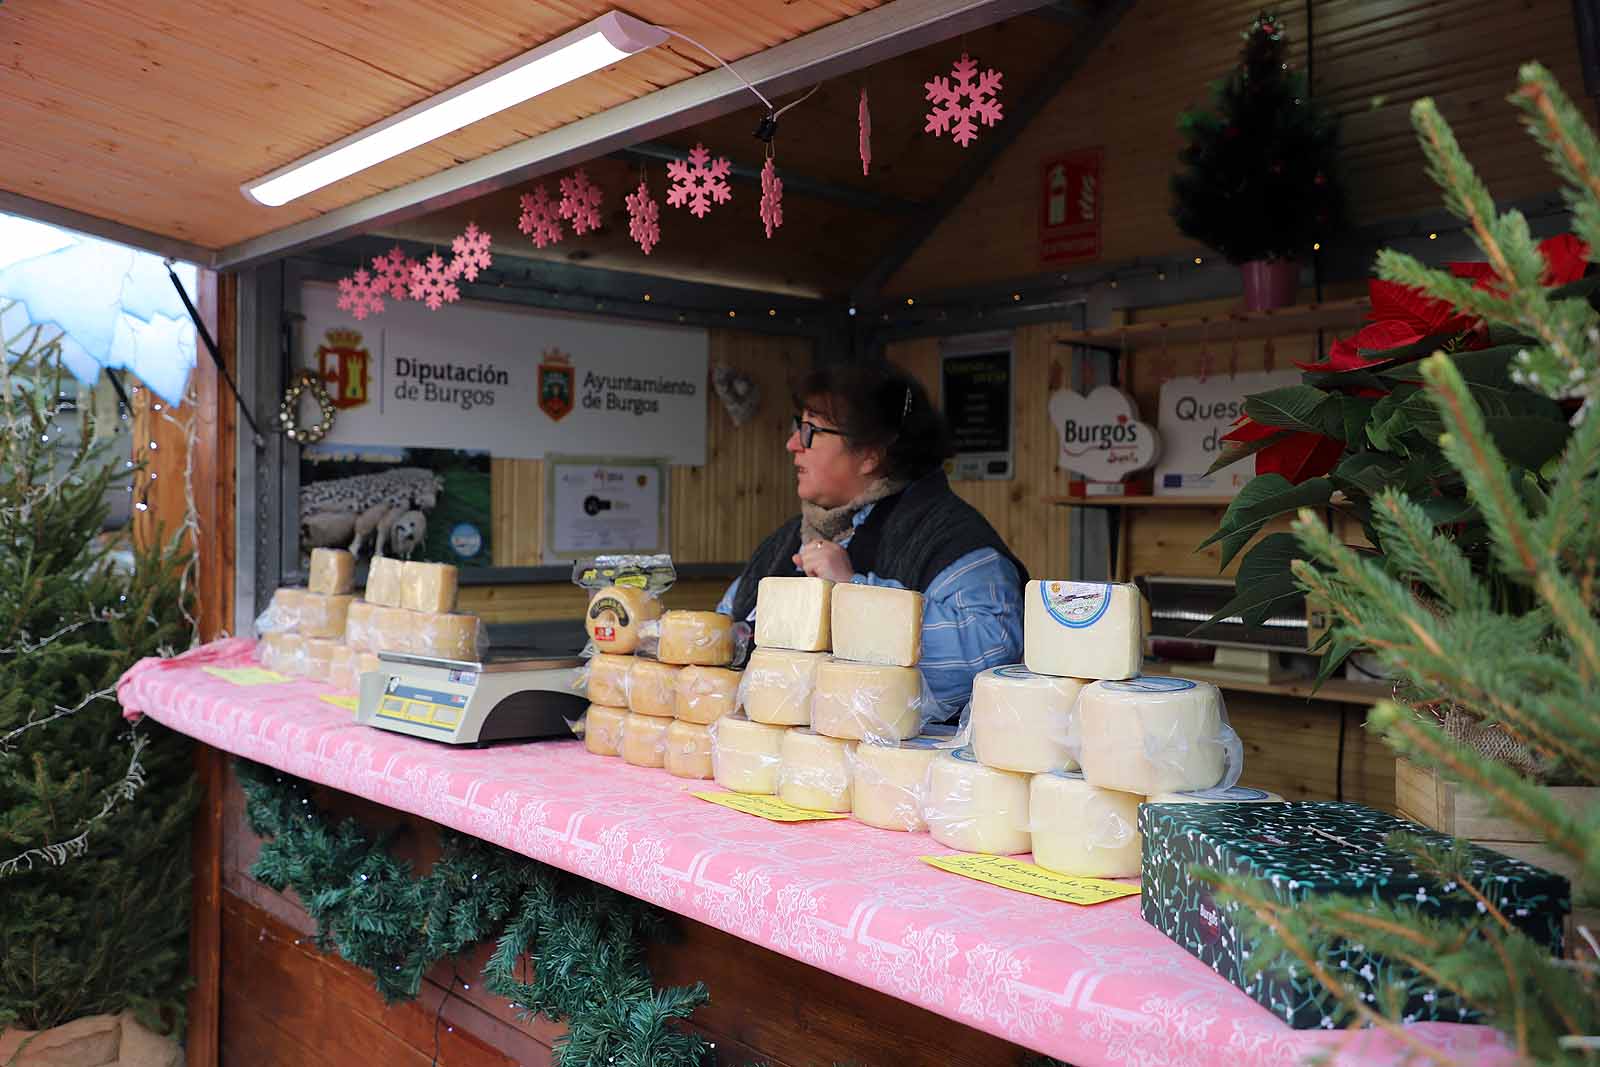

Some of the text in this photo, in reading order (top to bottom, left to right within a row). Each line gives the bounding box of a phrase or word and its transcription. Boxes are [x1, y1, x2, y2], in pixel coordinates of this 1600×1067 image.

[395, 357, 509, 386] Diputación
[583, 370, 696, 397] Ayuntamiento
[394, 381, 495, 410] de Burgos
[582, 390, 659, 416] de Burgos
[1064, 419, 1138, 450] Burgos
